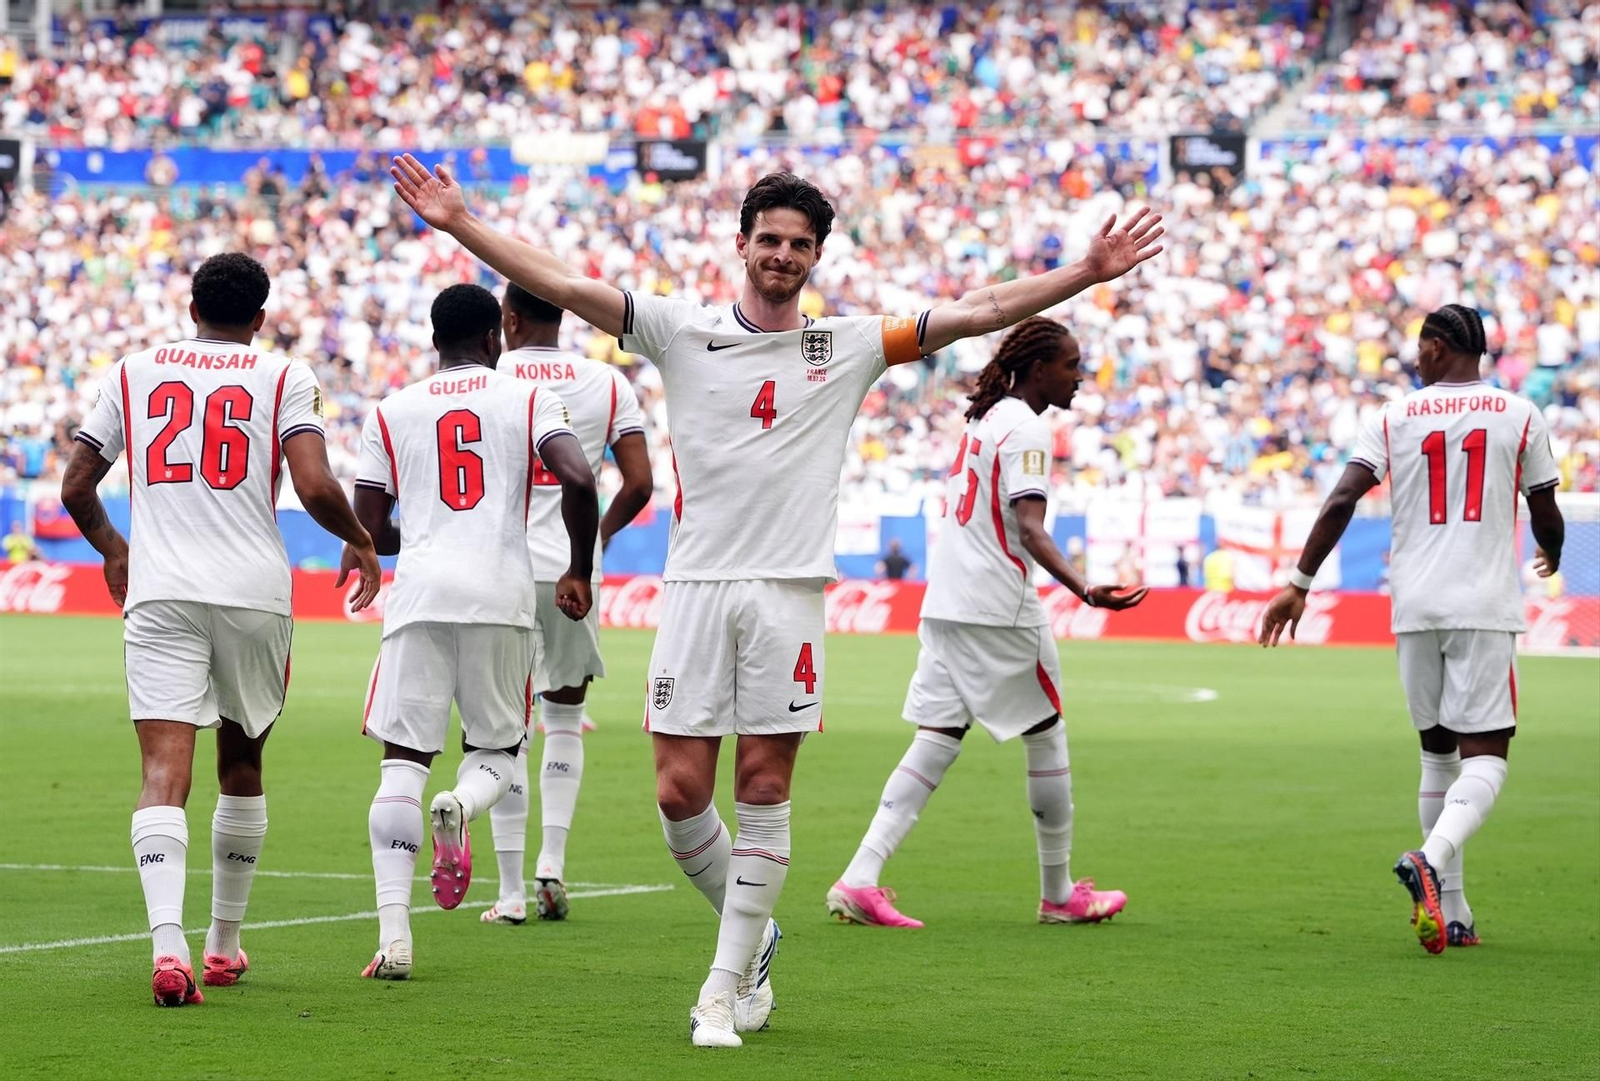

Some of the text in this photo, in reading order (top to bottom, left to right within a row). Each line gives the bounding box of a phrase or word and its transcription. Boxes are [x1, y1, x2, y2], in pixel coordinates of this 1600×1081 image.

[155, 348, 258, 370] QUANSAH
[515, 363, 576, 380] KONSA
[429, 375, 488, 395] GUEHI
[750, 380, 777, 429] 4
[1406, 395, 1507, 417] RASHFORD
[146, 380, 254, 490] 26
[436, 408, 485, 511] 6
[1421, 428, 1487, 524] 11
[793, 642, 817, 694] 4
[479, 764, 501, 781] ENG
[547, 761, 570, 773] ENG
[508, 783, 523, 796] NG
[391, 839, 418, 854] ENG
[140, 853, 165, 867] ENG
[227, 852, 256, 864] ENG
